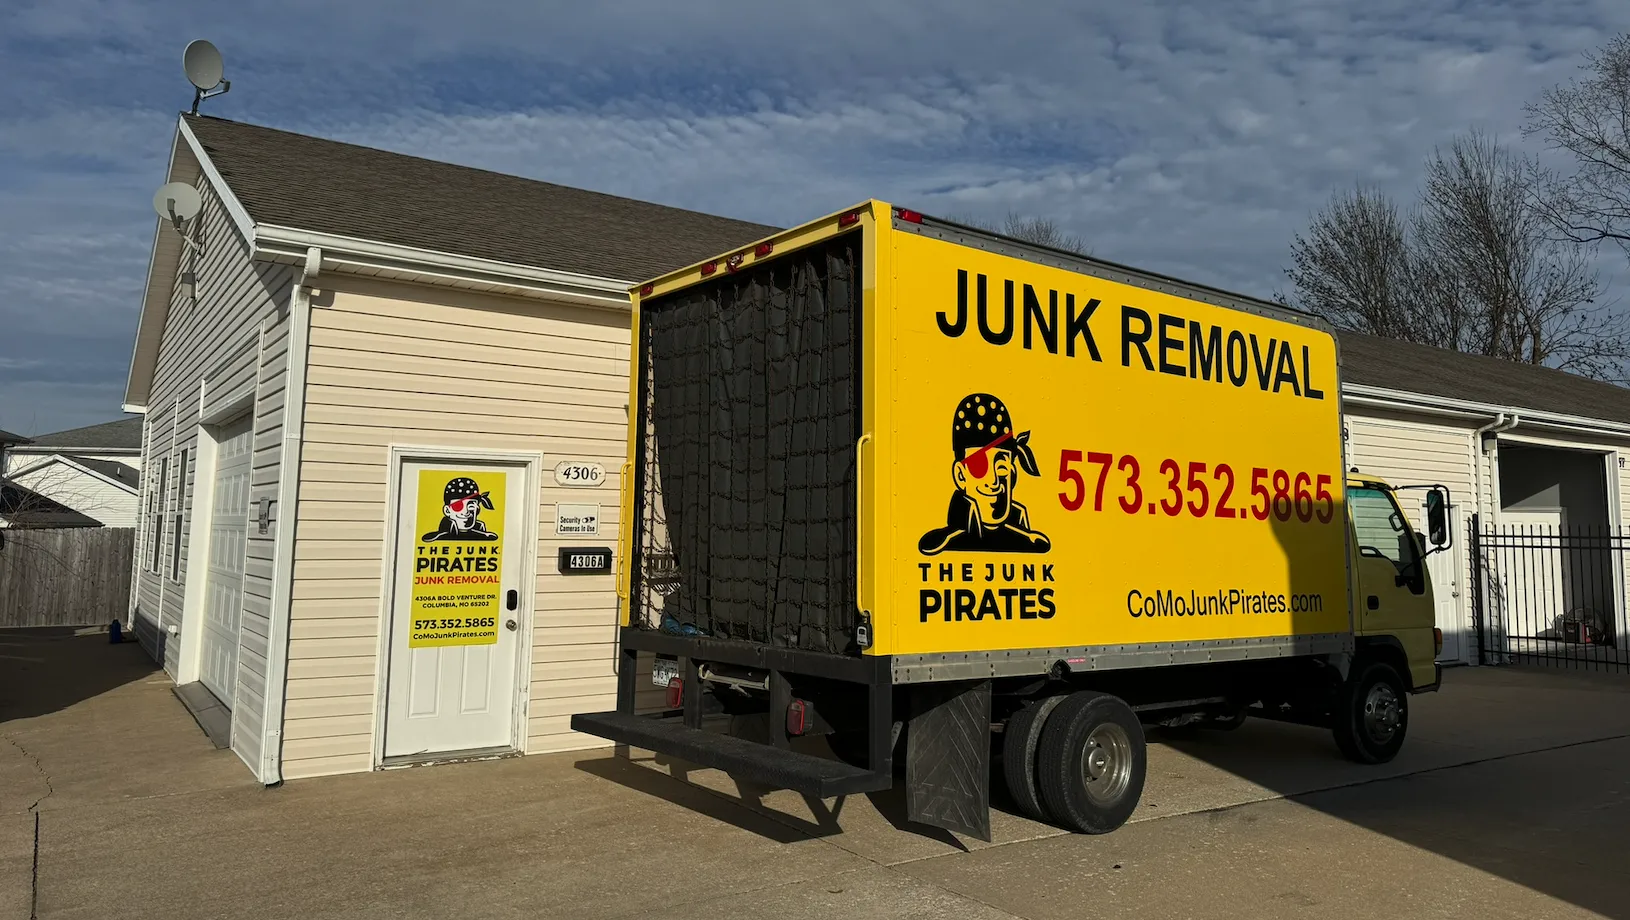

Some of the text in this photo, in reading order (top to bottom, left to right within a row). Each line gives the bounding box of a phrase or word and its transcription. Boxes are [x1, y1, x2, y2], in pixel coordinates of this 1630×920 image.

[935, 268, 1324, 400] JUNK REMOVAL
[563, 466, 599, 481] 4306
[1057, 448, 1334, 524] 573.352.5865
[560, 515, 581, 525] Security
[560, 524, 580, 532] Cameras
[417, 546, 499, 555] THE JUNK
[416, 557, 498, 573] PIRATES
[571, 555, 604, 568] 4306A
[918, 563, 1055, 582] THE JUNK
[414, 575, 500, 585] JUNK REMOVAL
[919, 588, 1057, 622] PIRATES
[1126, 589, 1323, 618] CoMoJunkPirates.com
[414, 617, 495, 630] 573.352.5865
[413, 630, 495, 640] CoMoJunkPirates.com
